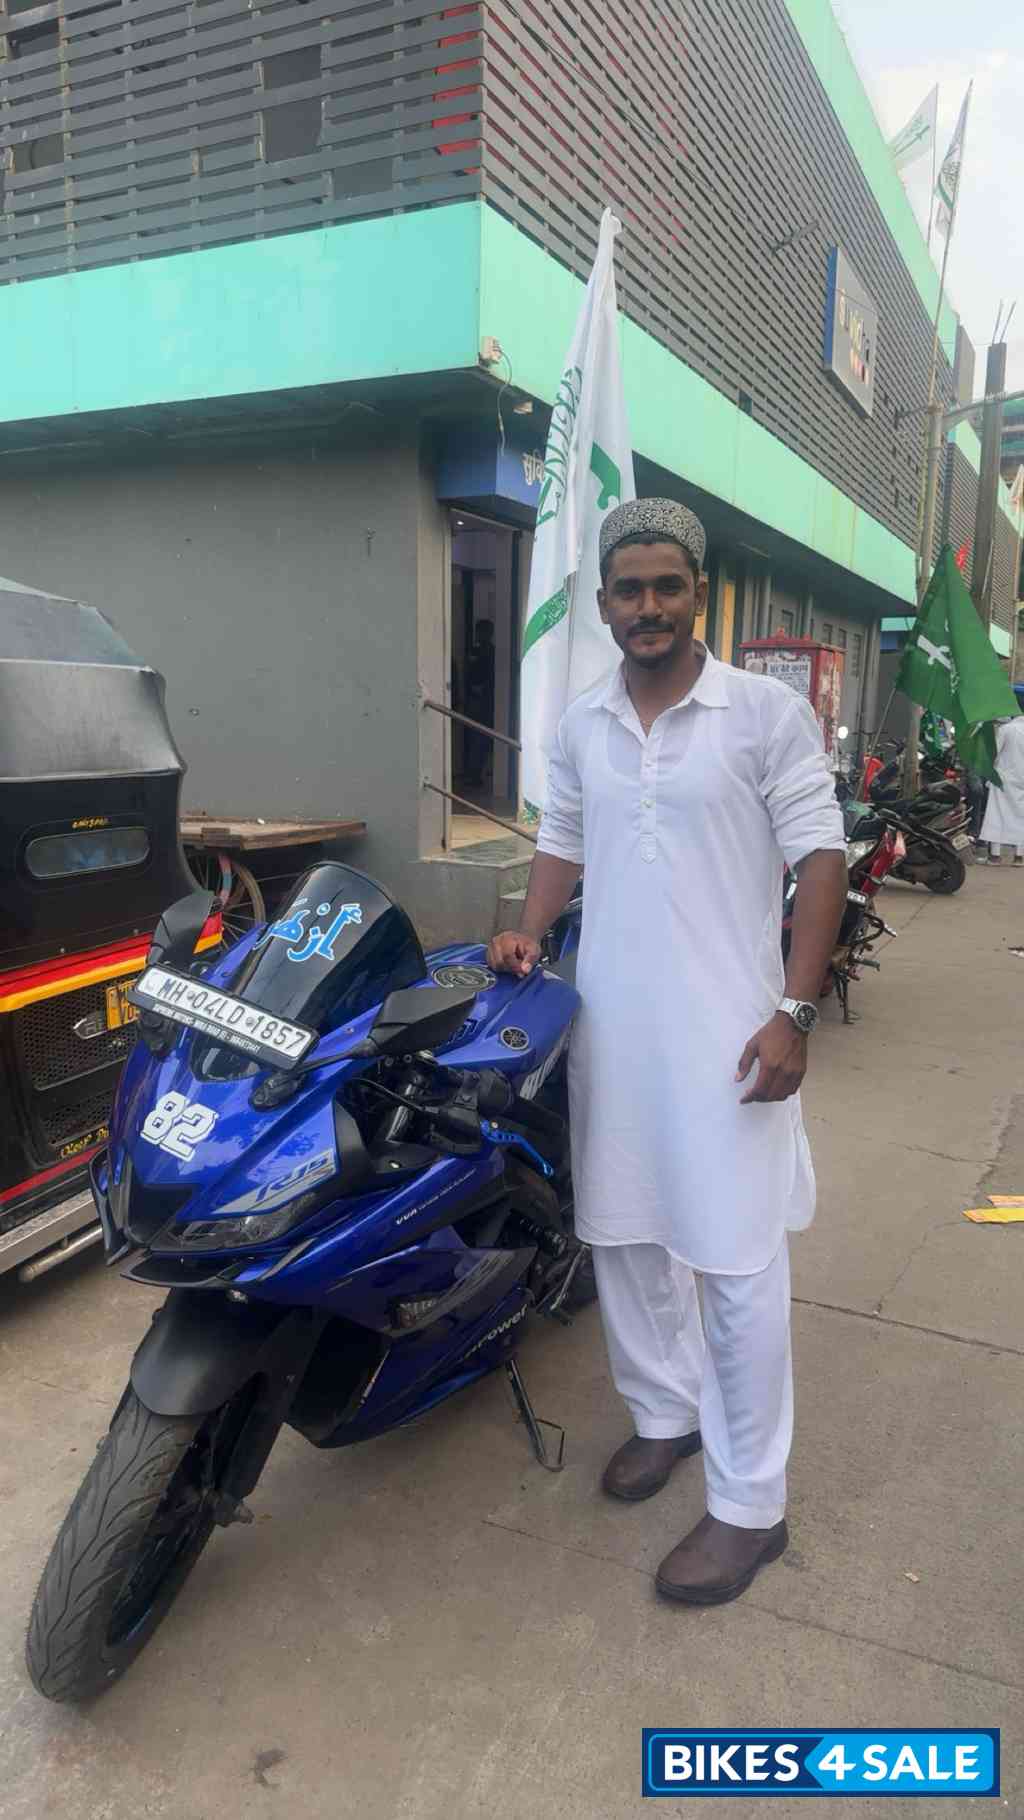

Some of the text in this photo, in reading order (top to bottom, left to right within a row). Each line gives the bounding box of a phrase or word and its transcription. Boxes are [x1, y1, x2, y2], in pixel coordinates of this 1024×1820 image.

[158, 978, 188, 1003] MH
[191, 992, 246, 1025] 04LD
[251, 1015, 306, 1050] 1857
[140, 1090, 220, 1163] 82
